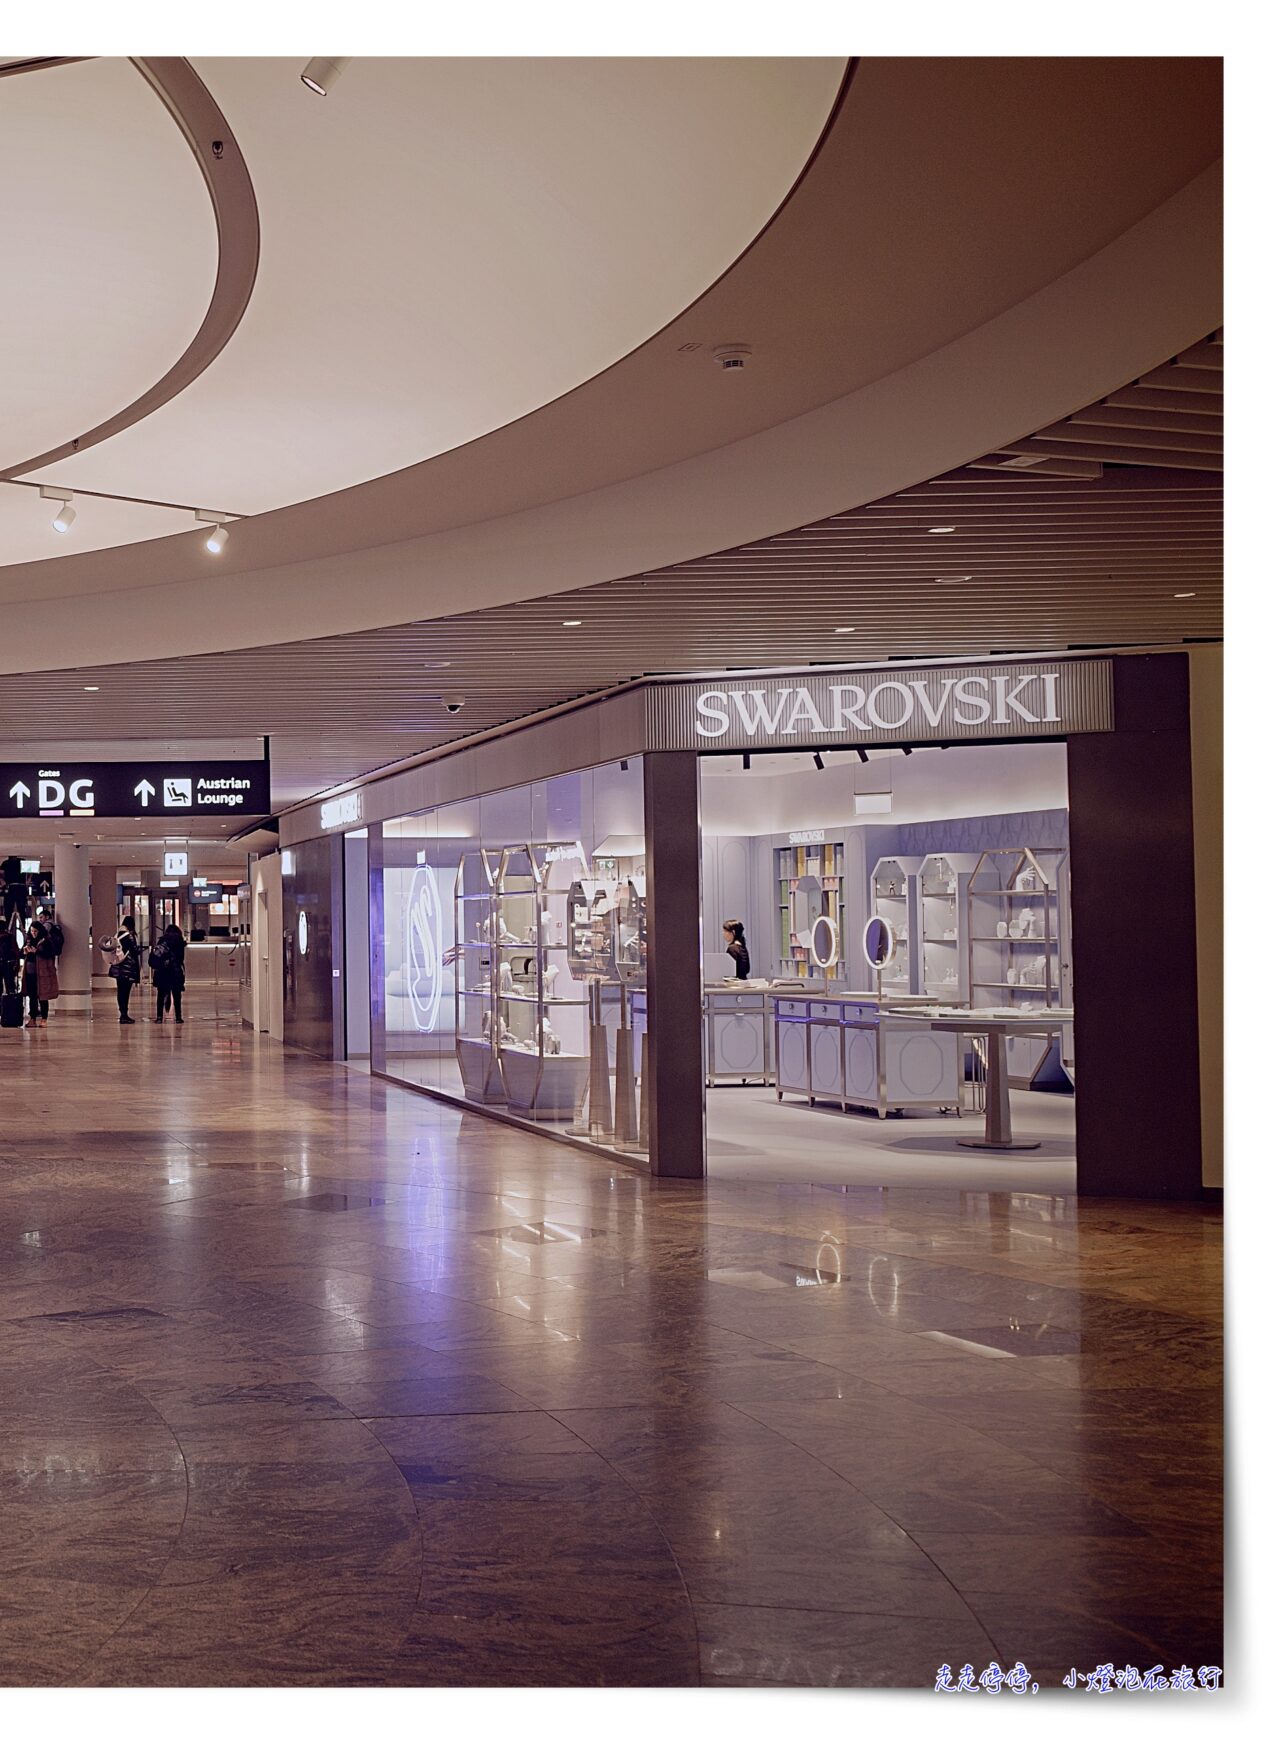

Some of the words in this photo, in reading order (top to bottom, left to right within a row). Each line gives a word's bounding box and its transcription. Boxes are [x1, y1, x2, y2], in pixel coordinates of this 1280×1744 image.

[696, 673, 1061, 738] SWAROVSKI
[38, 769, 61, 778] Gates
[196, 777, 251, 790] Austrian
[197, 792, 244, 805] Lounge
